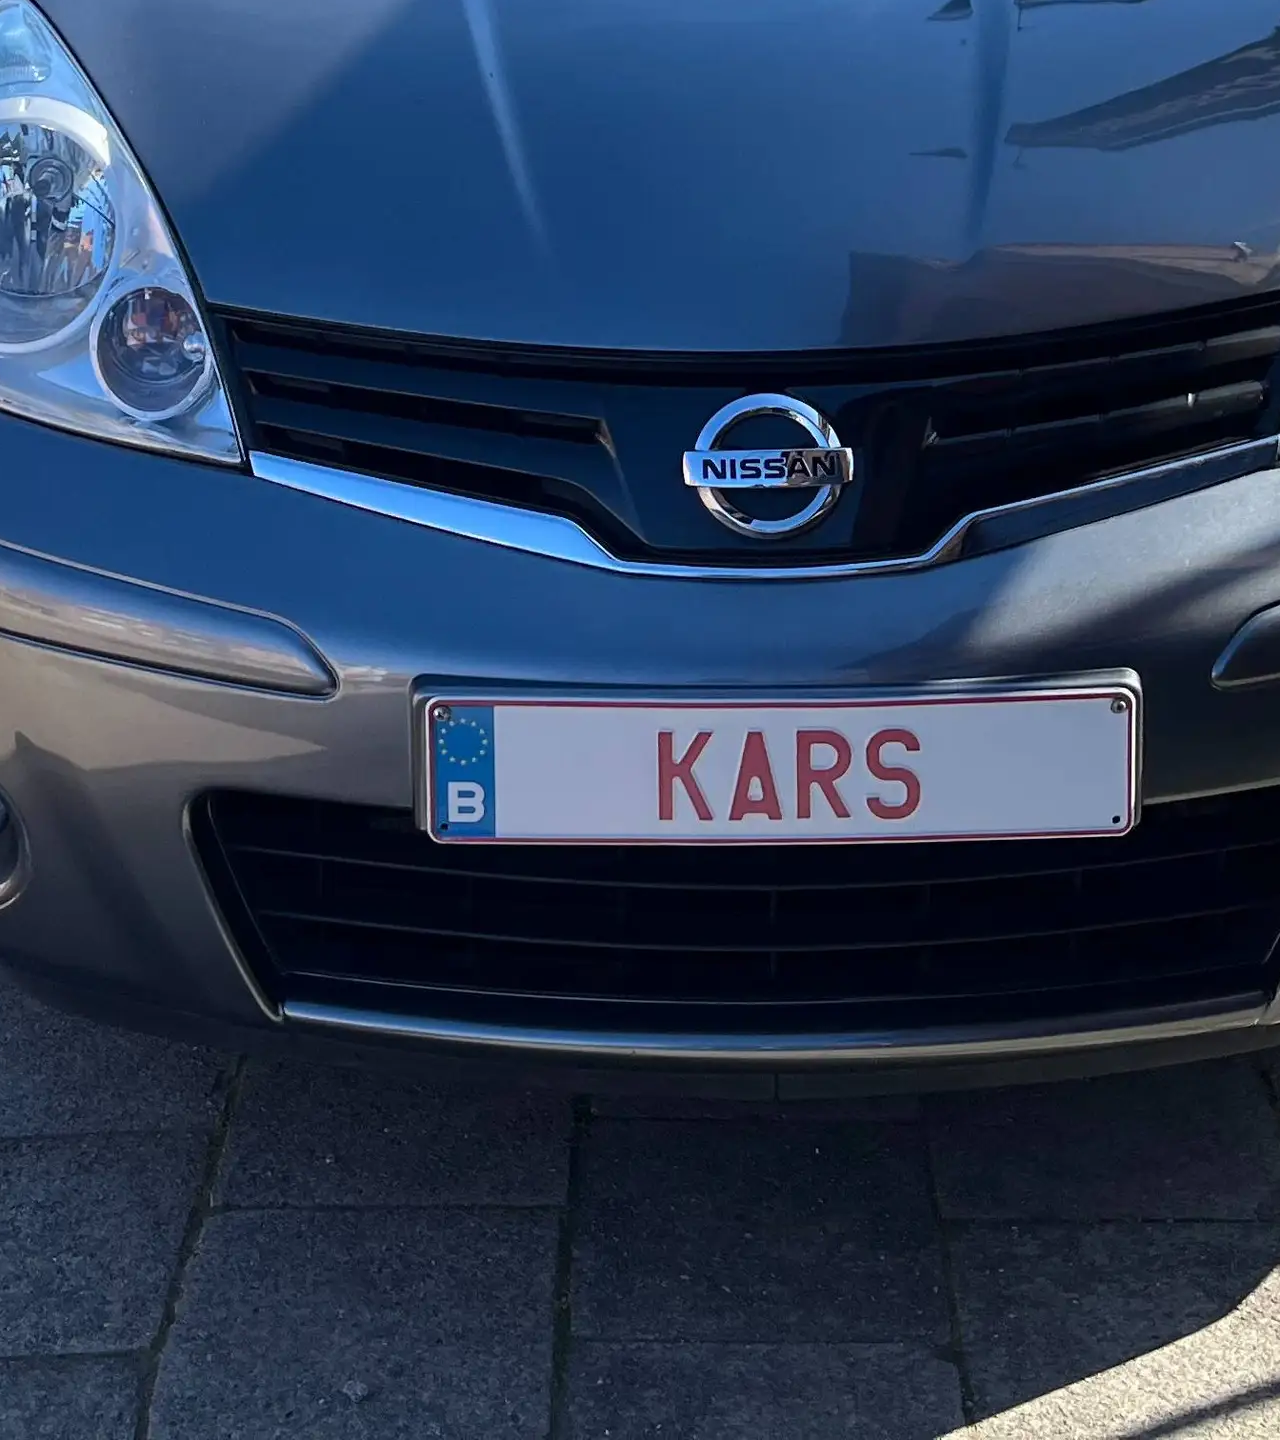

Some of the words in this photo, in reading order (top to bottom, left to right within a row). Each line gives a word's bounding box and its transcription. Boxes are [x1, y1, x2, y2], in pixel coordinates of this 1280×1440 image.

[702, 455, 836, 480] NISSAN
[657, 727, 921, 820] KARS
[447, 781, 486, 823] B
